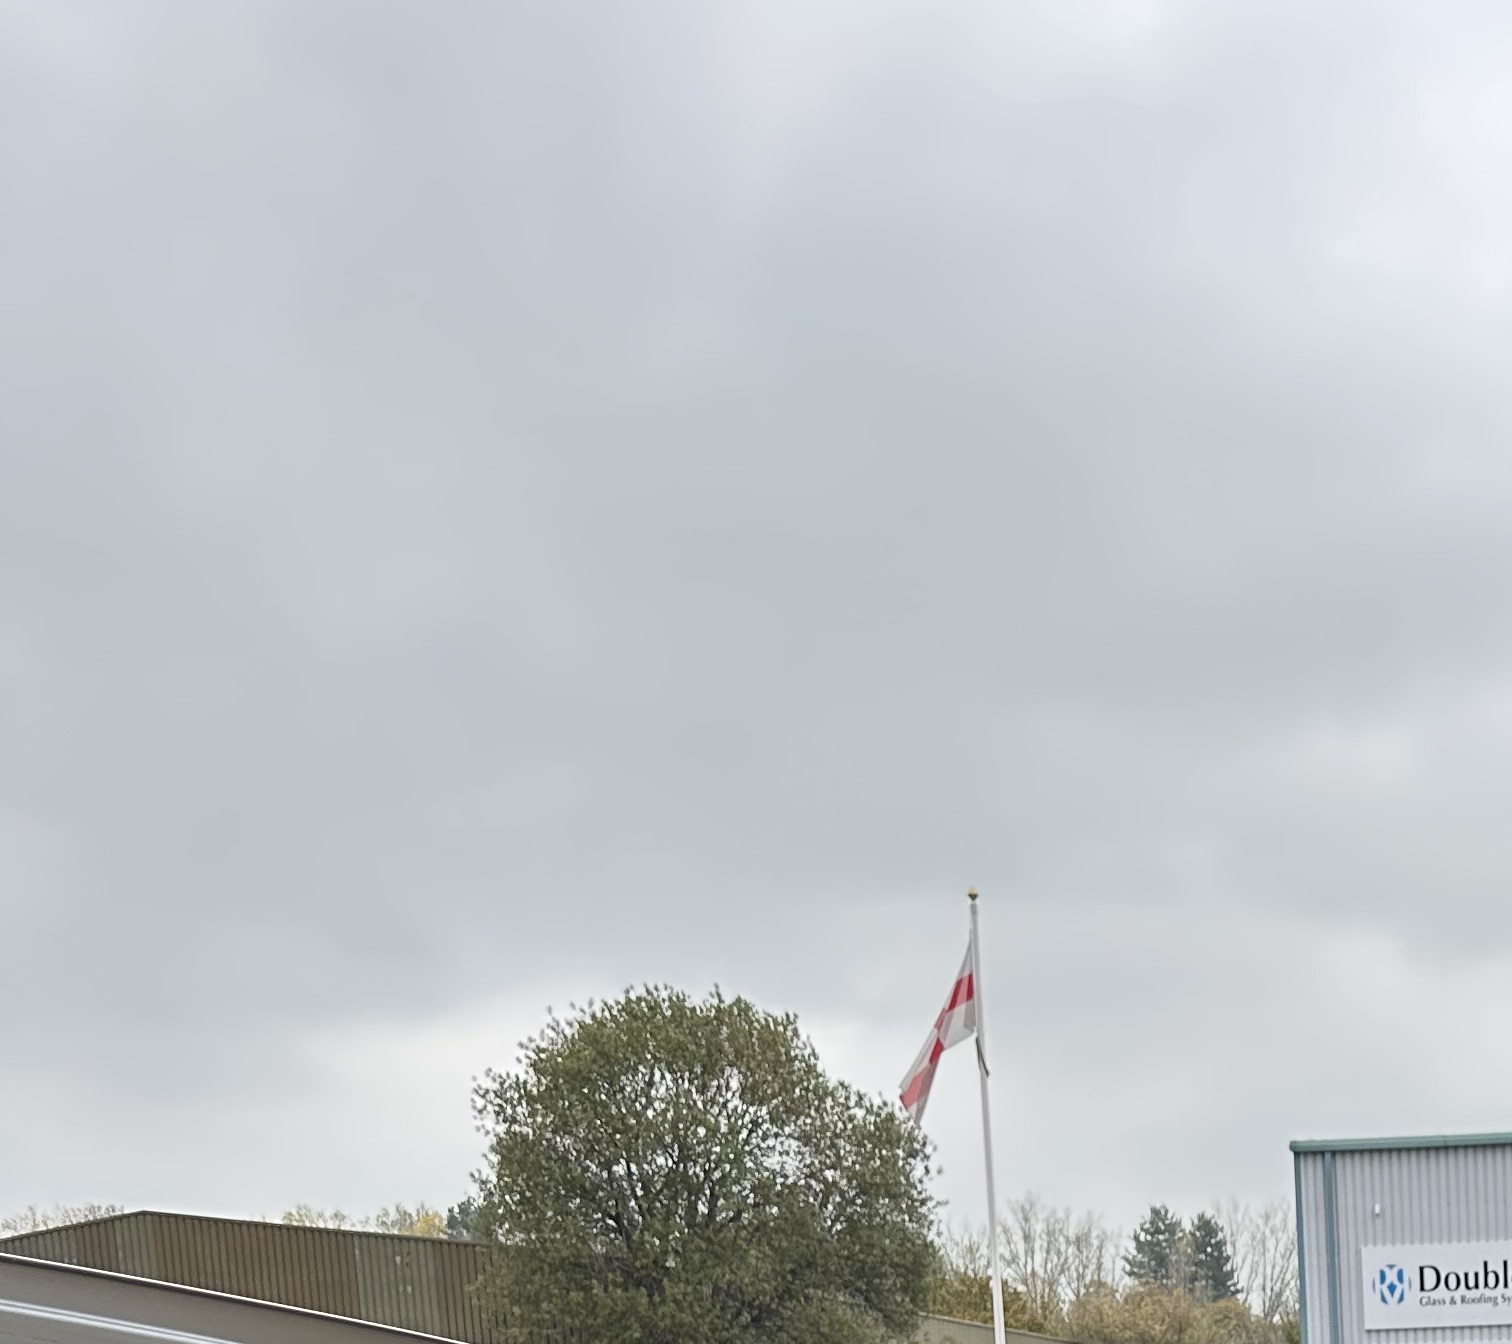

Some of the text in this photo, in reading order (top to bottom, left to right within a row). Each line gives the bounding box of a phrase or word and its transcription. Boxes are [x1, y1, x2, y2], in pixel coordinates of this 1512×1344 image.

[1419, 1295, 1446, 1307] Glass
[1449, 1295, 1457, 1305] &
[1460, 1293, 1499, 1307] Roofing
